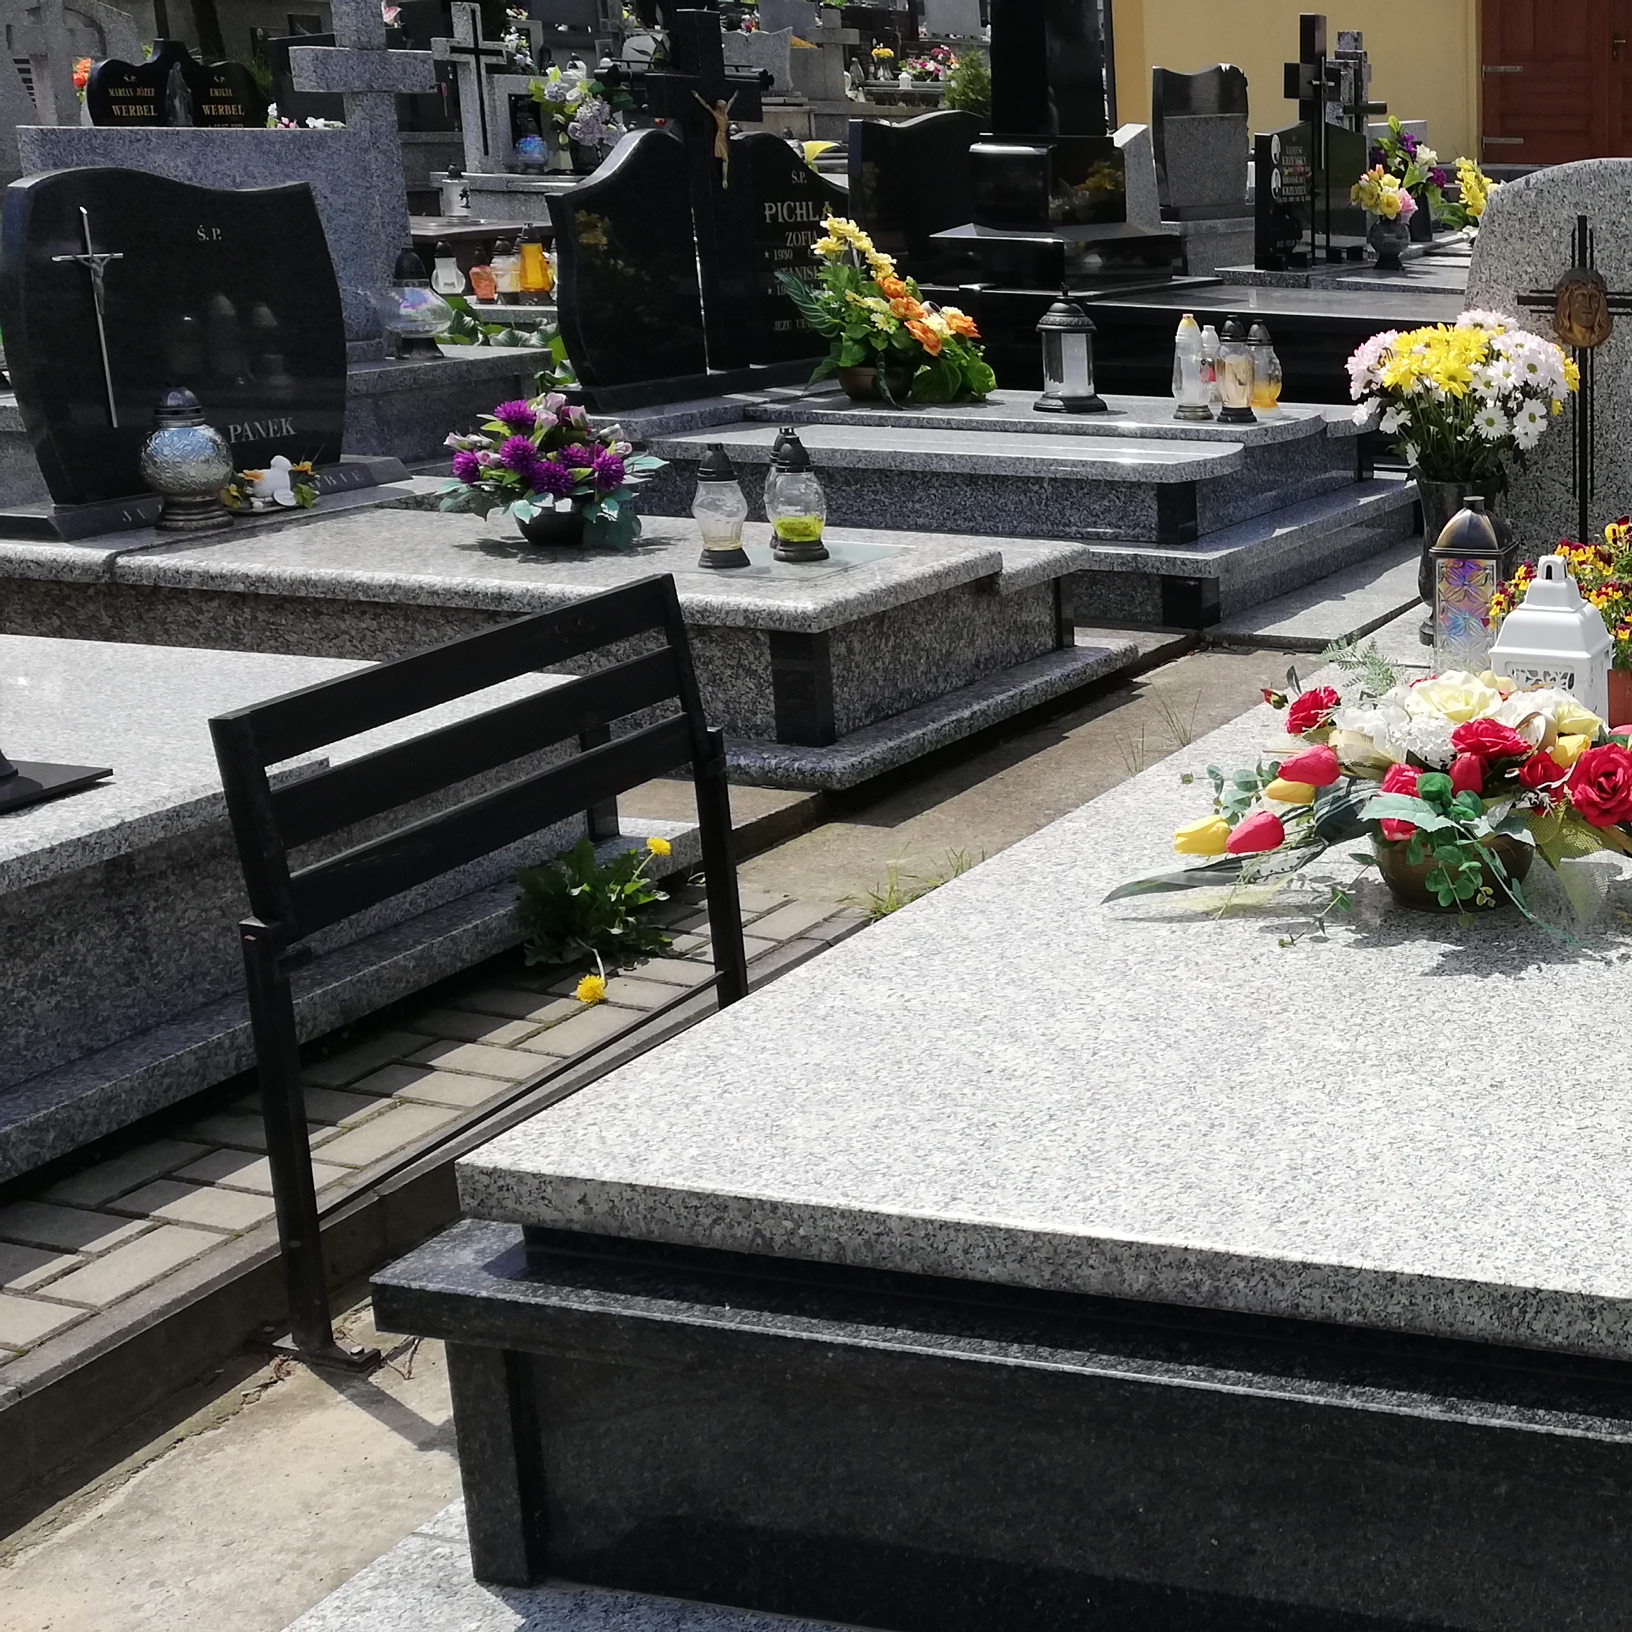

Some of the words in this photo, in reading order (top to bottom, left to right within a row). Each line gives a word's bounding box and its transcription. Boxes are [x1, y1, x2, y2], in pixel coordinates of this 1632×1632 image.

[112, 104, 158, 117] WERBEL
[202, 104, 245, 116] WERBEL
[764, 201, 832, 223] PICHLA
[227, 417, 297, 444] PANEK
